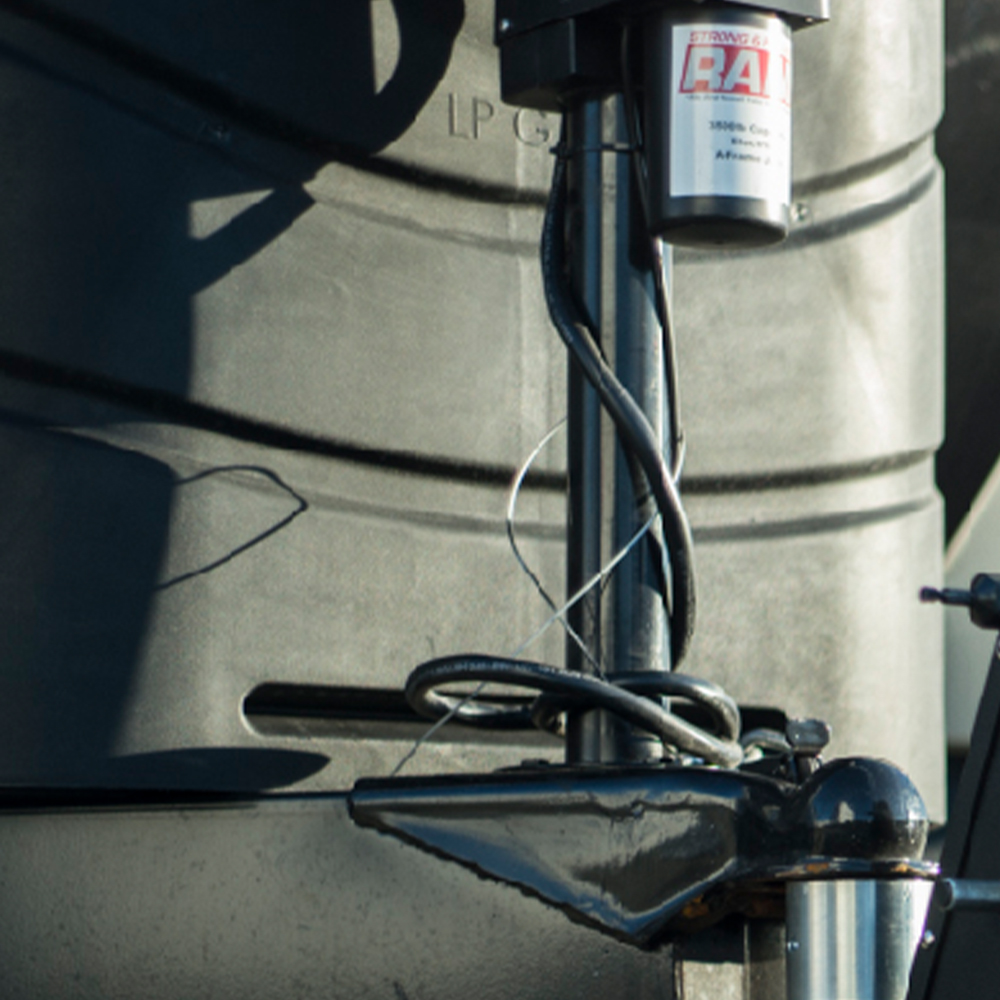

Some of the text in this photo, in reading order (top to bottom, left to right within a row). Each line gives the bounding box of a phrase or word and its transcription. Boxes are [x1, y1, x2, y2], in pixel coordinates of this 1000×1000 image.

[689, 30, 750, 45] STRONG
[681, 44, 784, 97] RA
[448, 92, 495, 141] LP
